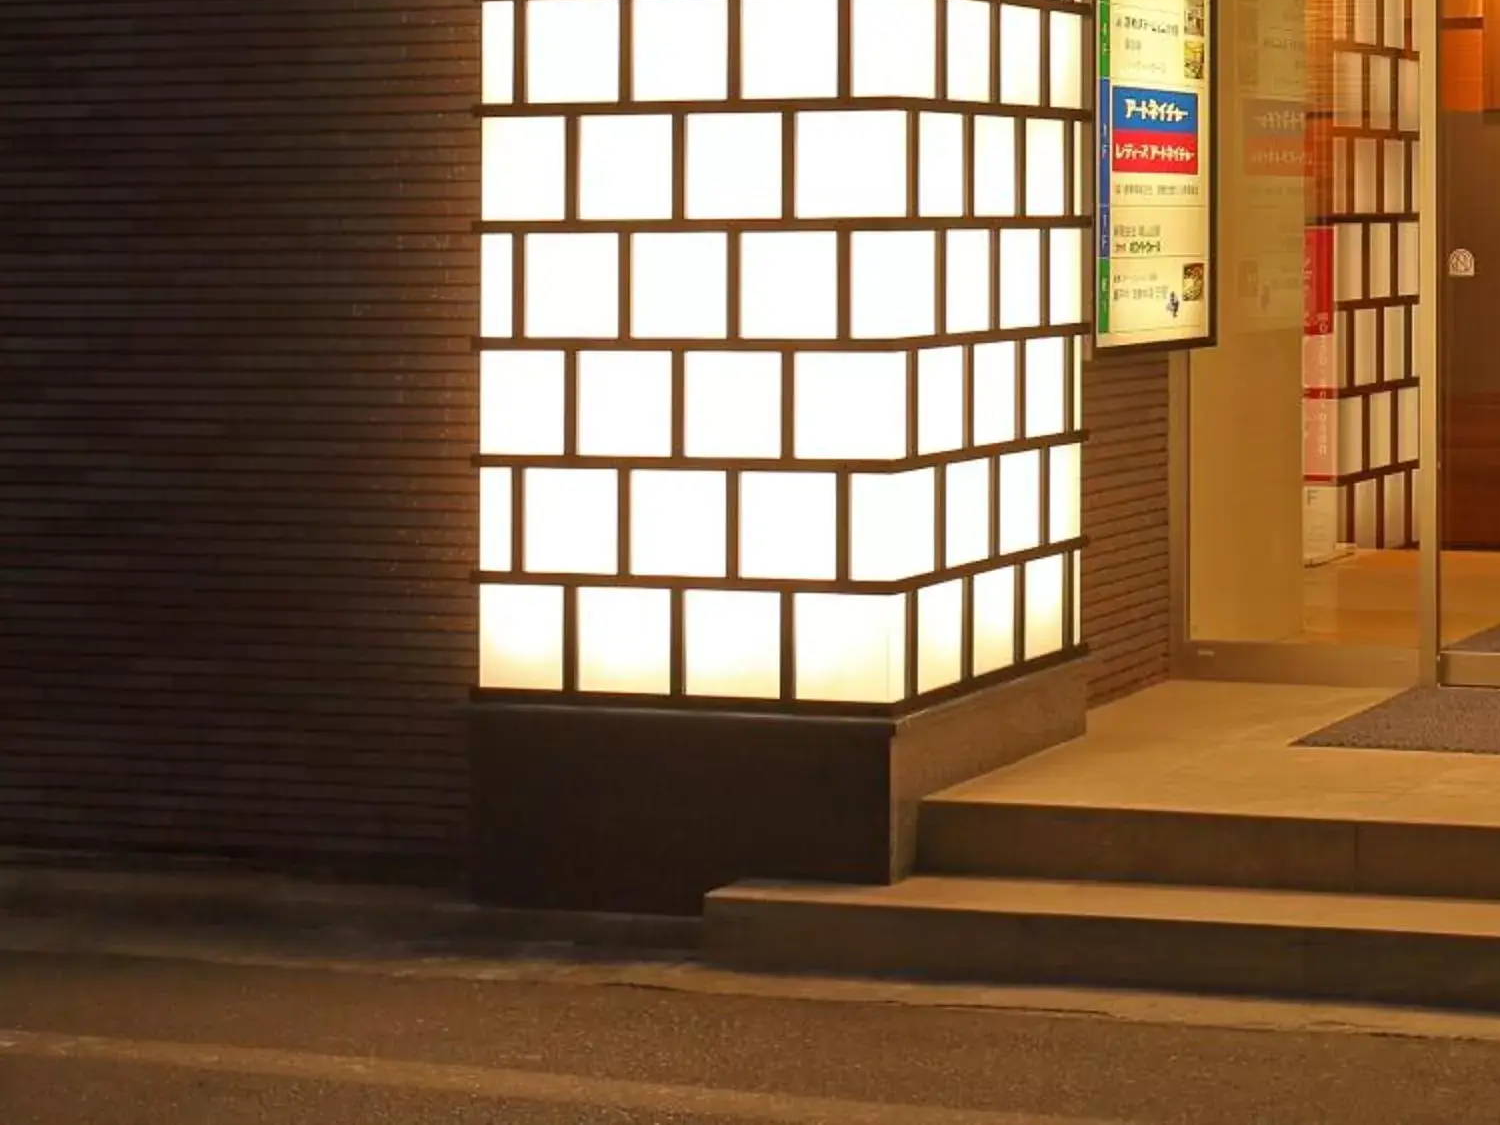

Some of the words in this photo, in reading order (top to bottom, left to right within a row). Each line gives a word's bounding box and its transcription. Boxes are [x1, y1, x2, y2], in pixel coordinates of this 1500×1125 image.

[1124, 98, 1189, 123] アートネイチャー
